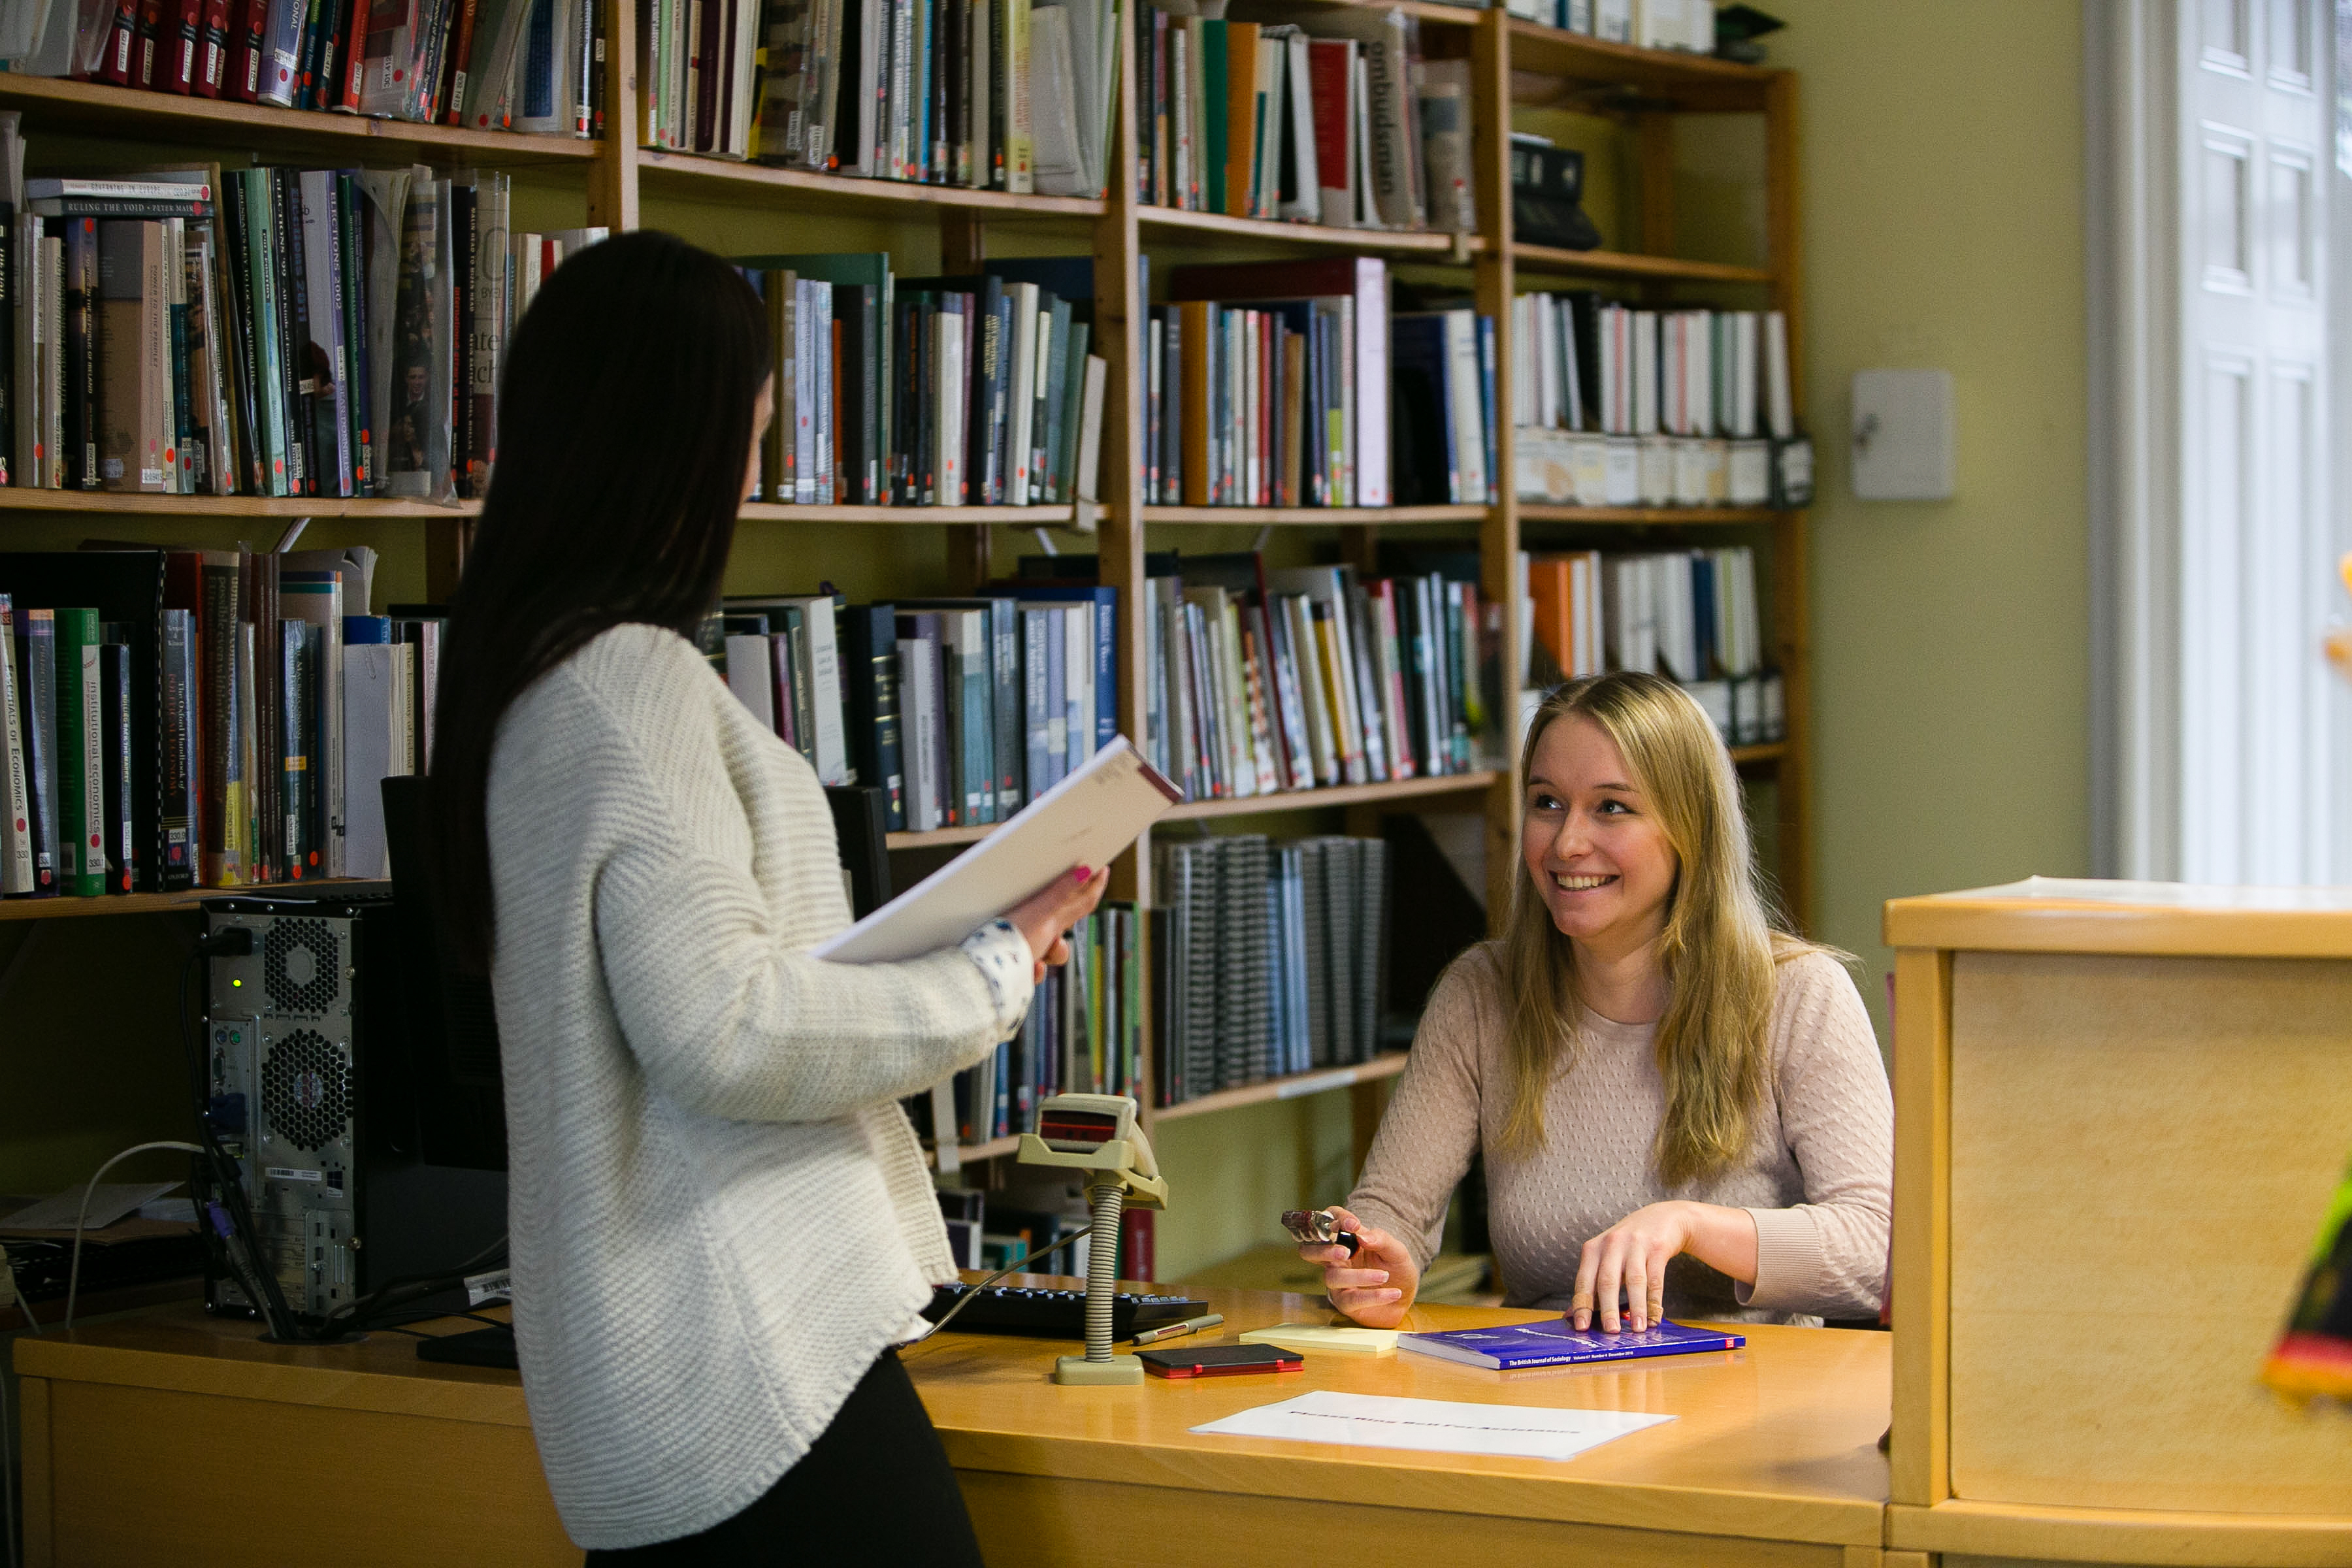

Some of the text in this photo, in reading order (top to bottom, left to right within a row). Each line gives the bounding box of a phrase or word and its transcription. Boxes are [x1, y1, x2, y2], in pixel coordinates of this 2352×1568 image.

[1371, 42, 1397, 195] ombudsman
[68, 203, 100, 212] RULING
[104, 203, 122, 212] THE
[124, 203, 144, 212] VOID
[240, 189, 248, 244] BRENNAN'S
[276, 178, 286, 253] ELECTIONS
[331, 192, 342, 310] ELECTIONS 2002
[90, 681, 99, 760] institutional
[406, 672, 414, 718] Economy
[6, 664, 23, 811] ESSENTIALS OF ECONOMICS
[92, 764, 101, 834] economics
